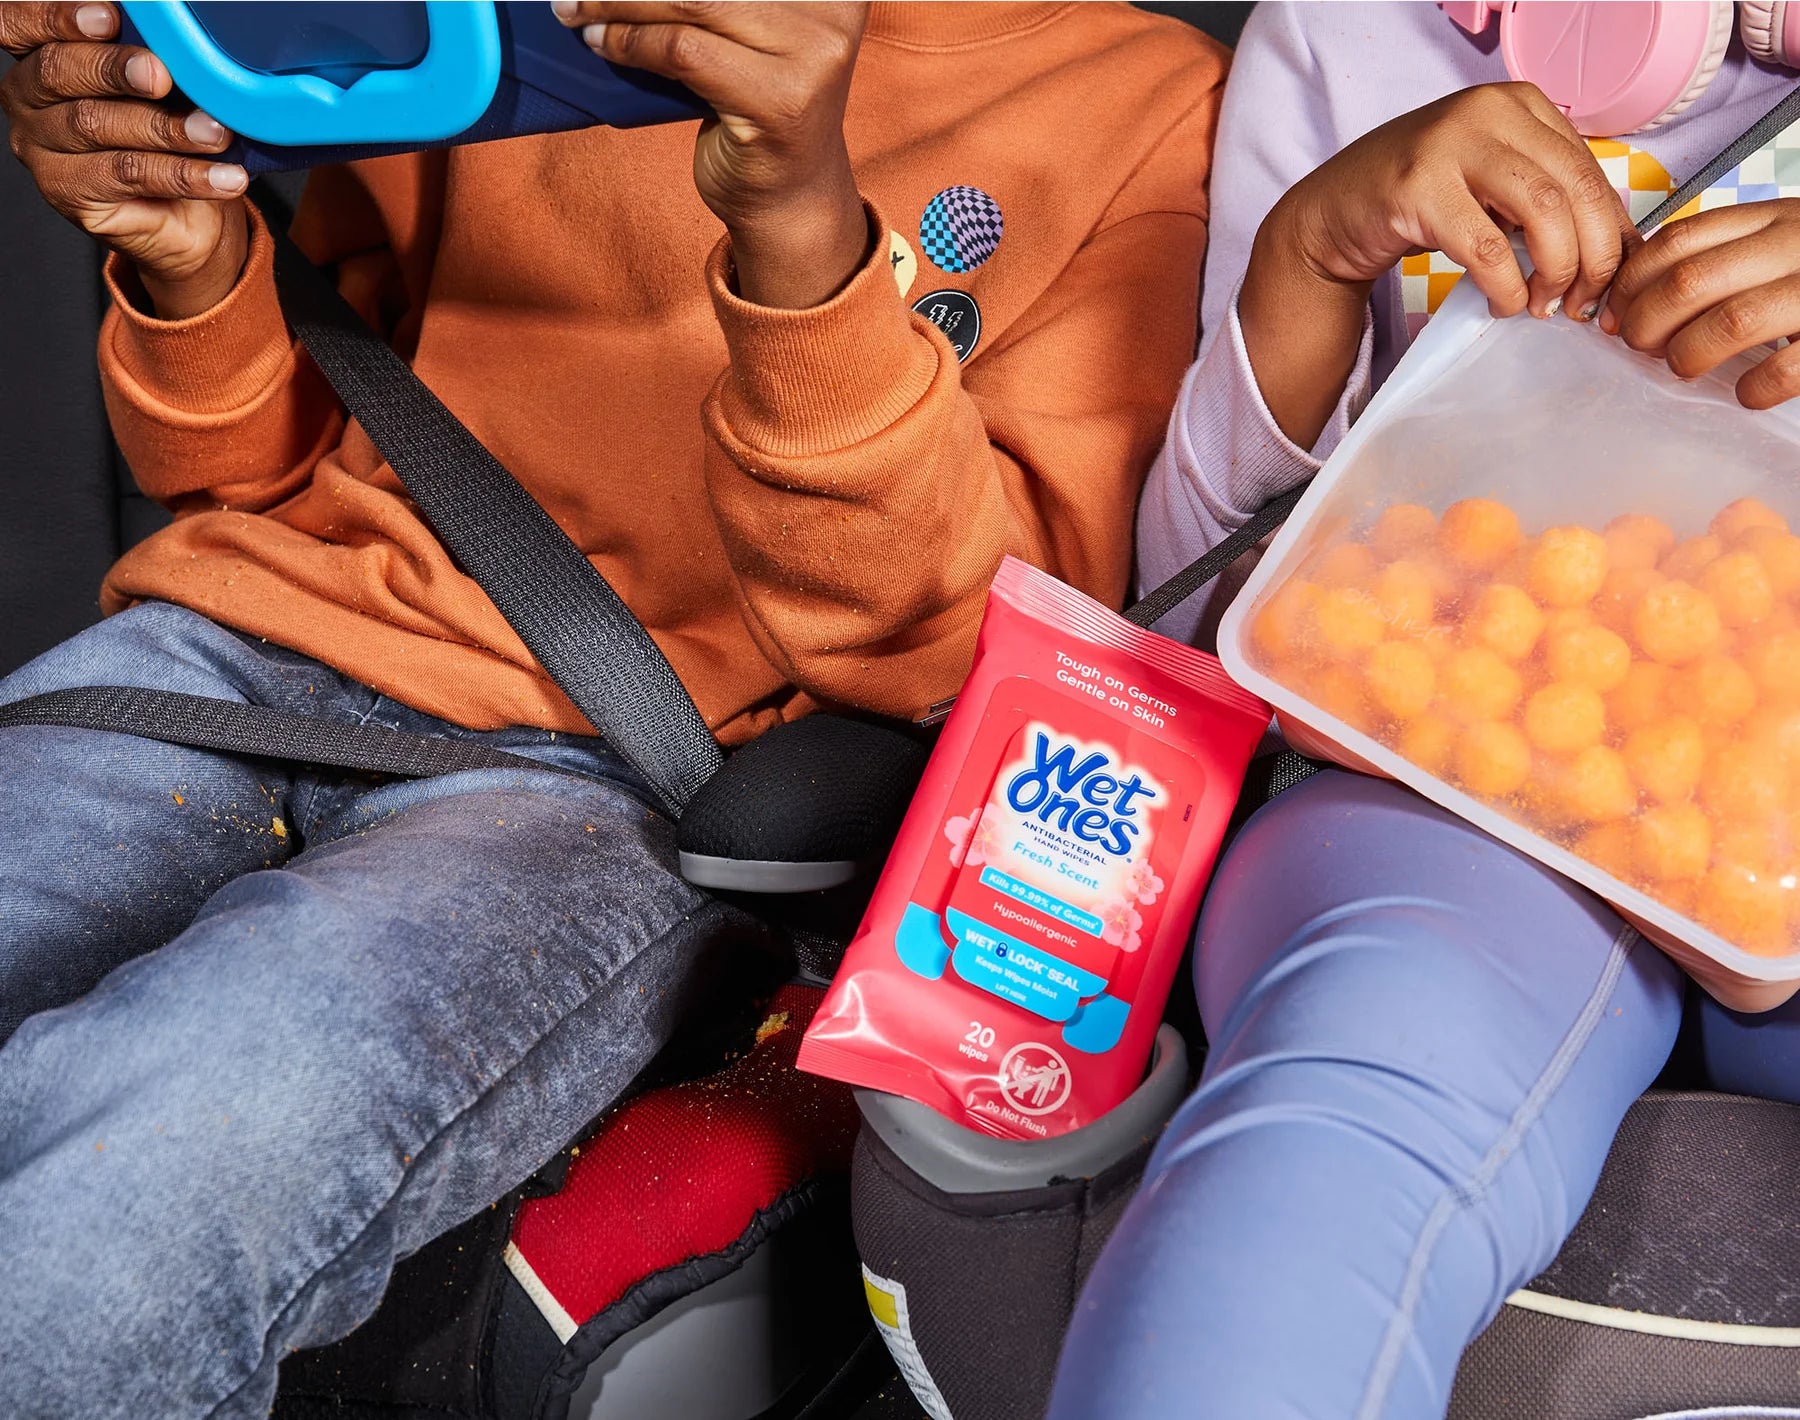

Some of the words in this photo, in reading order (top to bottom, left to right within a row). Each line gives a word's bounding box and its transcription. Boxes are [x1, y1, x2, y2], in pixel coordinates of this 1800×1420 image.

[1056, 651, 1101, 681] Tough
[1104, 676, 1125, 692] on
[1128, 686, 1178, 718] Germs
[1056, 669, 1107, 701] Gentle
[1109, 696, 1130, 712] on
[1132, 705, 1165, 729] Skin
[1035, 731, 1156, 816] Wet
[1007, 769, 1139, 856] Ones
[1013, 841, 1054, 868] Fresh
[1057, 862, 1100, 890] Scent
[1022, 820, 1108, 866] ANTIBACTERIAL
[1034, 836, 1060, 852] HAND
[1062, 849, 1091, 867] WIPES
[988, 873, 1009, 889] Kills
[1010, 884, 1049, 908] 99.99%
[1050, 904, 1064, 915] of
[993, 901, 1078, 948] Hypoallergenic
[965, 928, 997, 951] WET
[1047, 967, 1080, 992] SEAL
[958, 1043, 989, 1063] wipes
[965, 1021, 996, 1048] 20
[986, 1100, 1000, 1114] Do
[1001, 1109, 1020, 1124] Not
[1020, 1115, 1047, 1137] Flush
